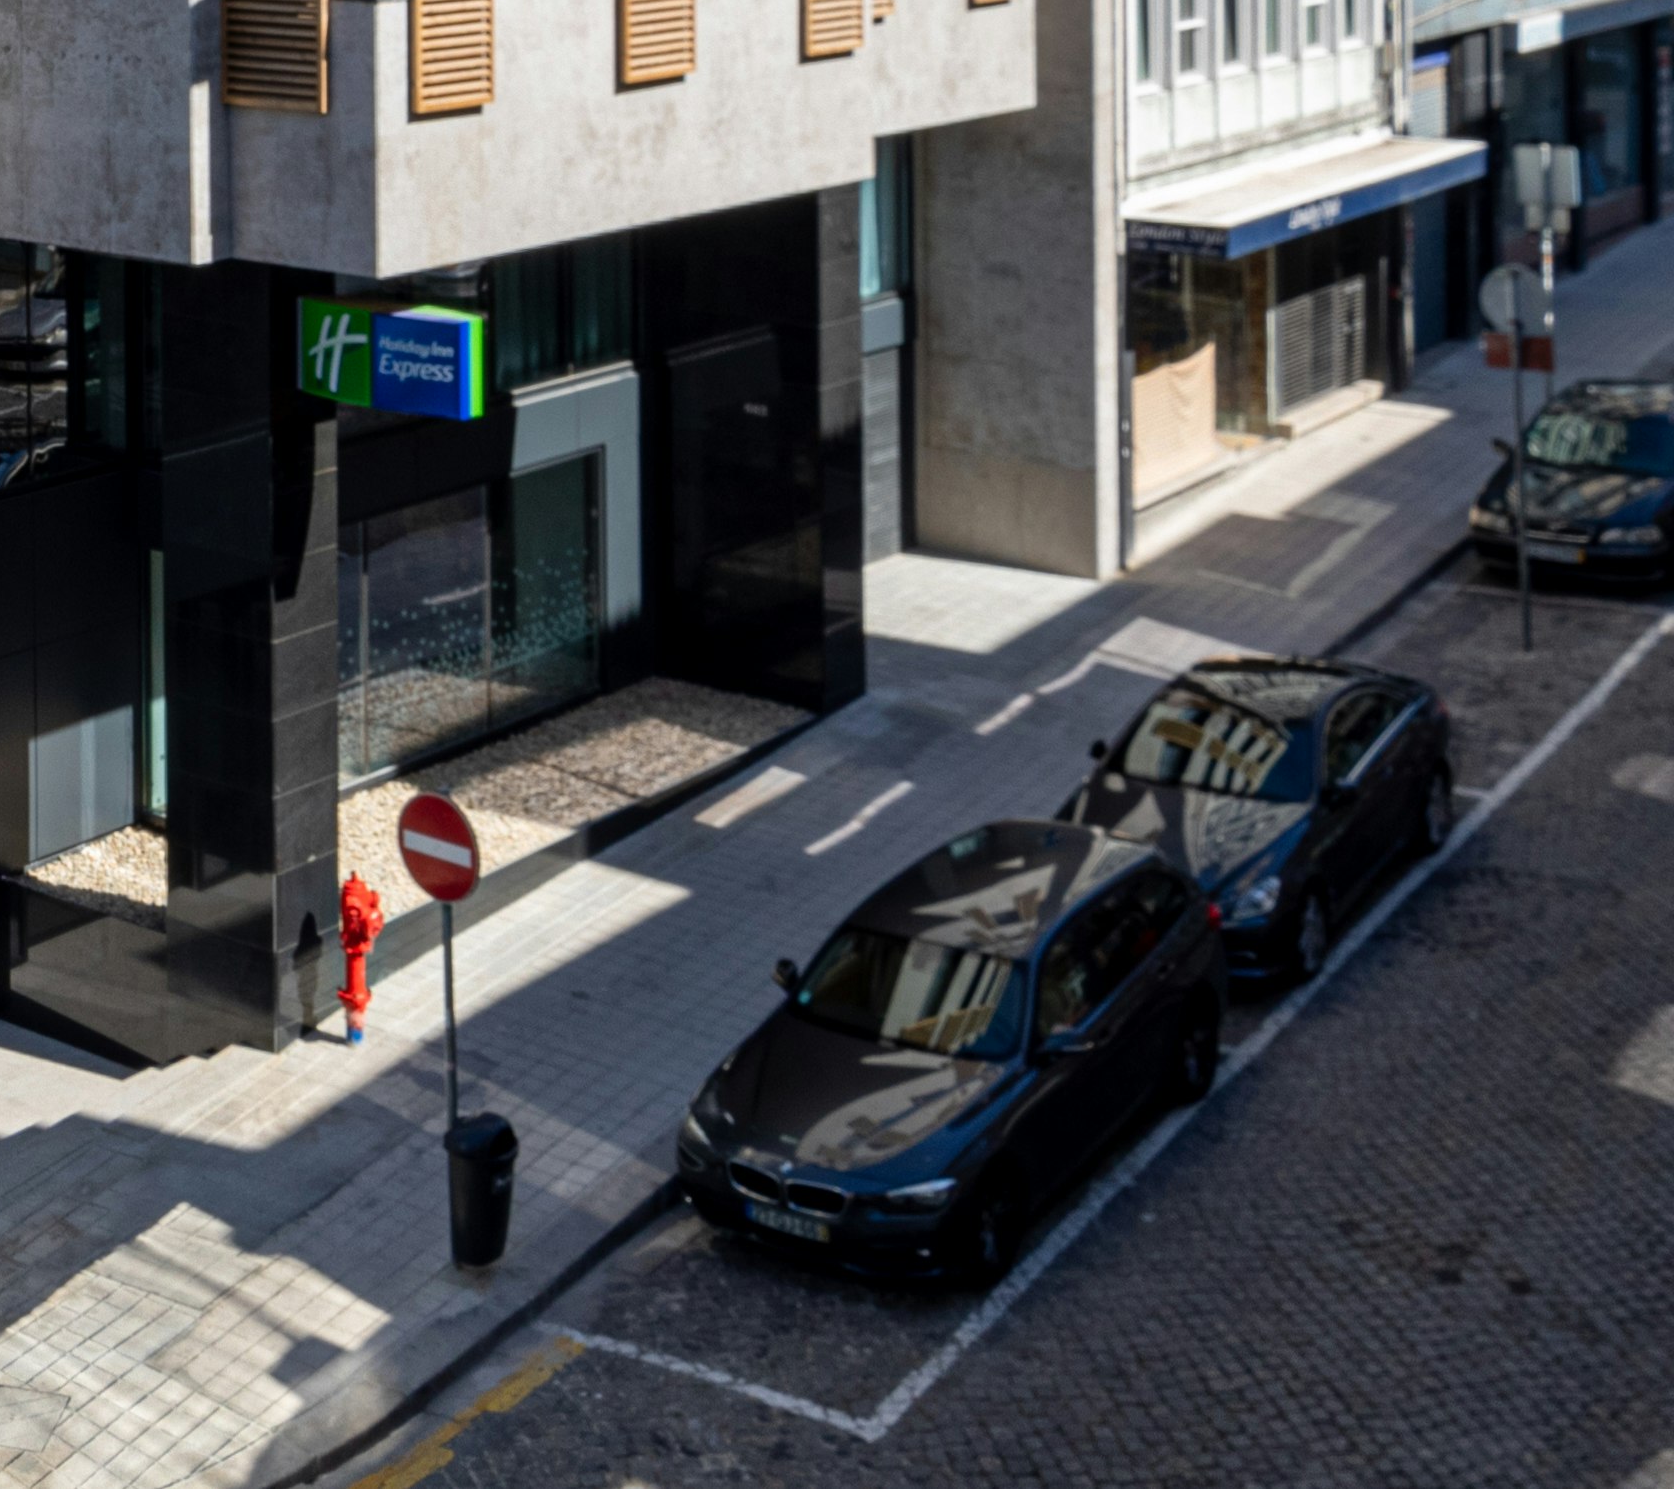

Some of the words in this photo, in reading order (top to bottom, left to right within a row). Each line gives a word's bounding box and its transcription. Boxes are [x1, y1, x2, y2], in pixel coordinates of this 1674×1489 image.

[378, 335, 431, 359] Holiday
[431, 341, 455, 358] Inn
[378, 353, 455, 383] Express
